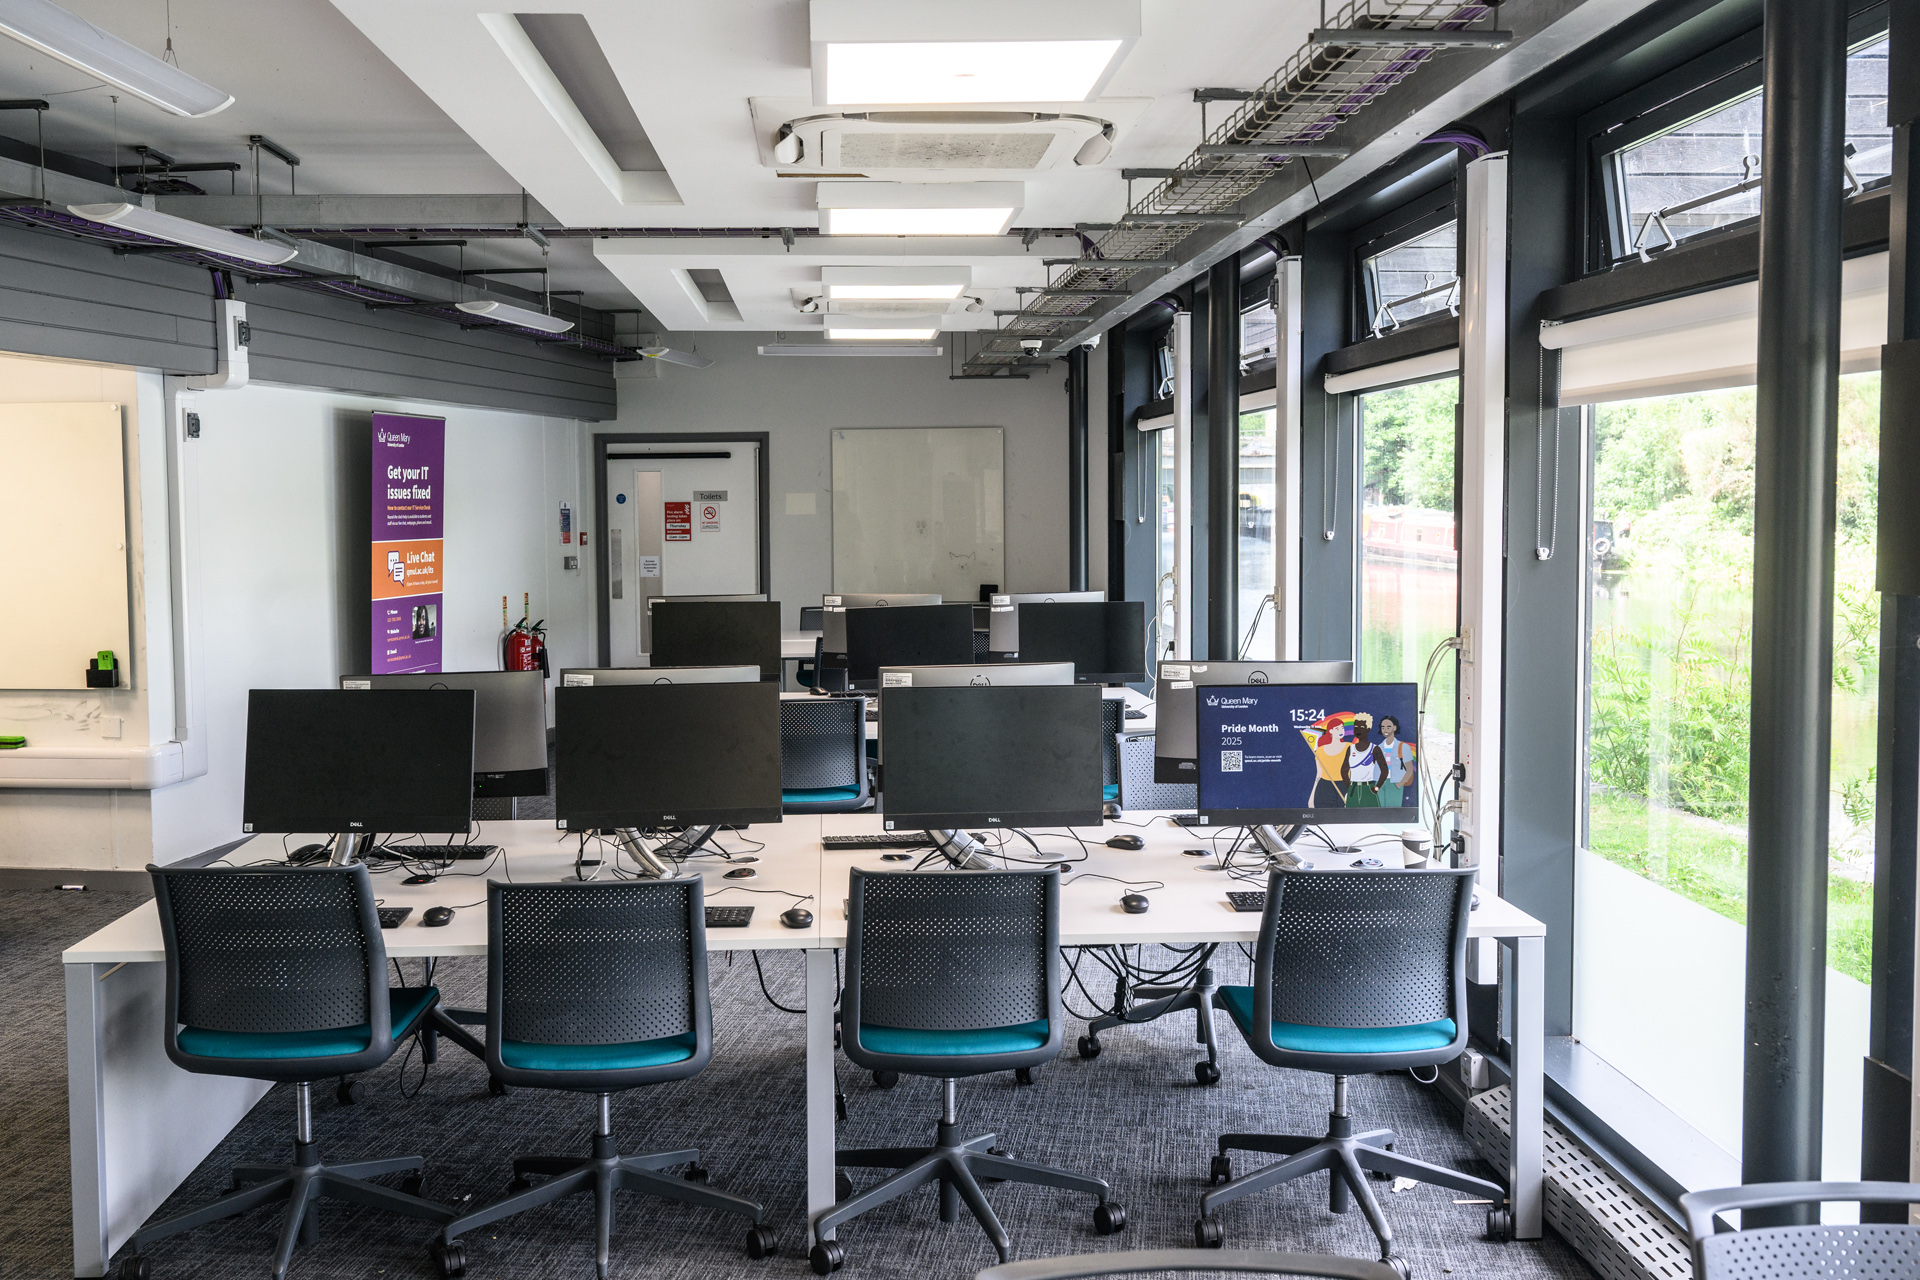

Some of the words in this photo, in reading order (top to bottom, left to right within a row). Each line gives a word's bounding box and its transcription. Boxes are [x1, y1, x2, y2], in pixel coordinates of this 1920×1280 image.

[387, 432, 400, 442] Queen
[401, 433, 411, 444] Mary
[387, 465, 402, 480] Get
[402, 468, 420, 483] your
[421, 466, 429, 480] IT
[387, 484, 411, 500] issues
[412, 484, 431, 500] fixed
[406, 551, 420, 564] Live
[420, 550, 435, 563] Chat
[406, 566, 434, 577] qmul.ac.uk/its
[1221, 697, 1241, 705] Queen
[1242, 697, 1258, 706] Mary
[1290, 709, 1326, 722] 15:24
[1221, 724, 1247, 733] Pride
[1248, 724, 1279, 733] Month
[1221, 737, 1242, 746] 2025
